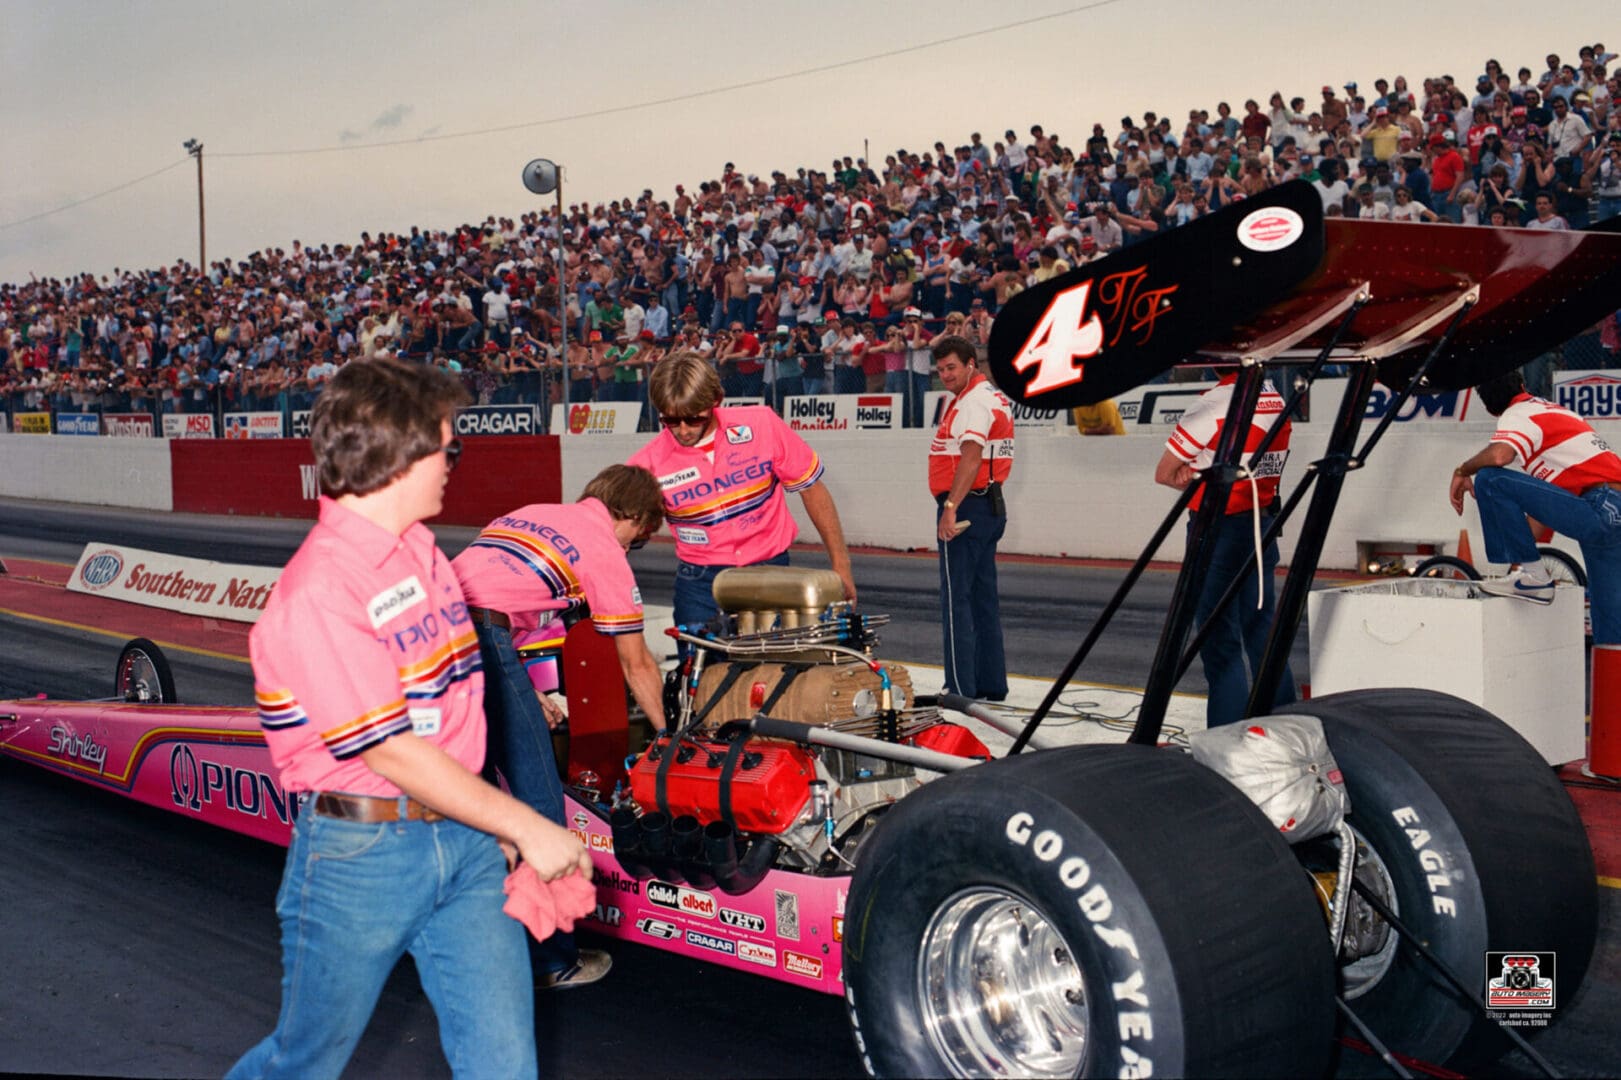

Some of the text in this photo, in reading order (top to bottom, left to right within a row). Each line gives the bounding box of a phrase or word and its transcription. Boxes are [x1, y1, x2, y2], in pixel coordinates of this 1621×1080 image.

[1012, 279, 1104, 398] 4
[790, 398, 835, 423] Holley
[857, 407, 892, 423] Holley
[103, 416, 151, 437] Winston
[186, 415, 212, 432] MSD
[456, 412, 531, 434] CRAGAR
[671, 461, 774, 507] PIONEER
[85, 555, 120, 585] NHRA
[124, 563, 217, 604] Southern
[47, 727, 108, 775] Shirley
[1391, 806, 1457, 919] EAGLE
[682, 893, 714, 914] albert
[721, 909, 764, 931] VHT
[687, 932, 734, 953] CRAGAR
